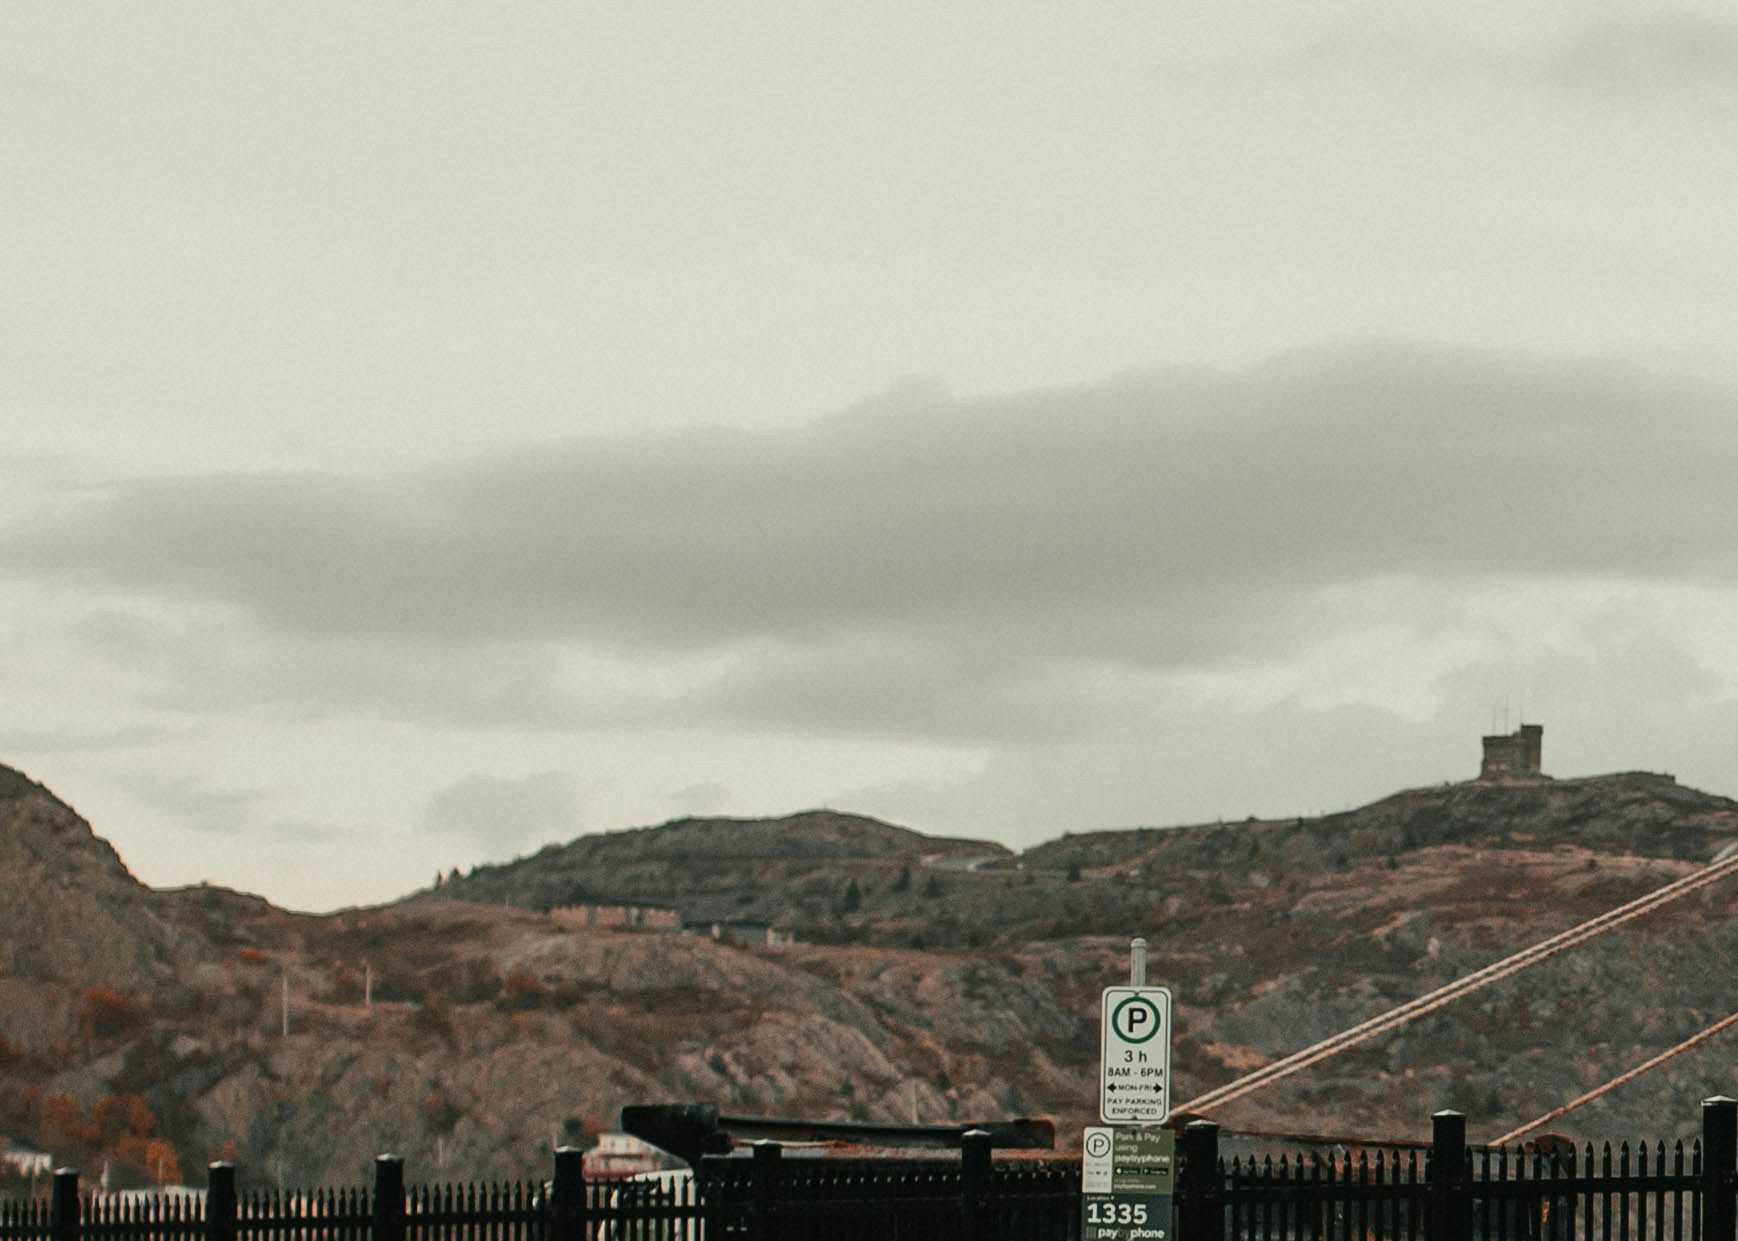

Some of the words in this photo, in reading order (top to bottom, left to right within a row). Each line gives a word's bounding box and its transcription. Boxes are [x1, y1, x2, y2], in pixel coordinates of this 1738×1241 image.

[1128, 1007, 1147, 1033] P
[1124, 1050, 1134, 1062] 3
[1138, 1050, 1147, 1062] h
[1107, 1067, 1130, 1077] 8AM
[1140, 1067, 1163, 1077] 6PM
[1125, 1098, 1162, 1106] PARKING
[1144, 1132, 1160, 1143] Pay
[1093, 1138, 1105, 1153] P
[1087, 1203, 1148, 1224] 1335
